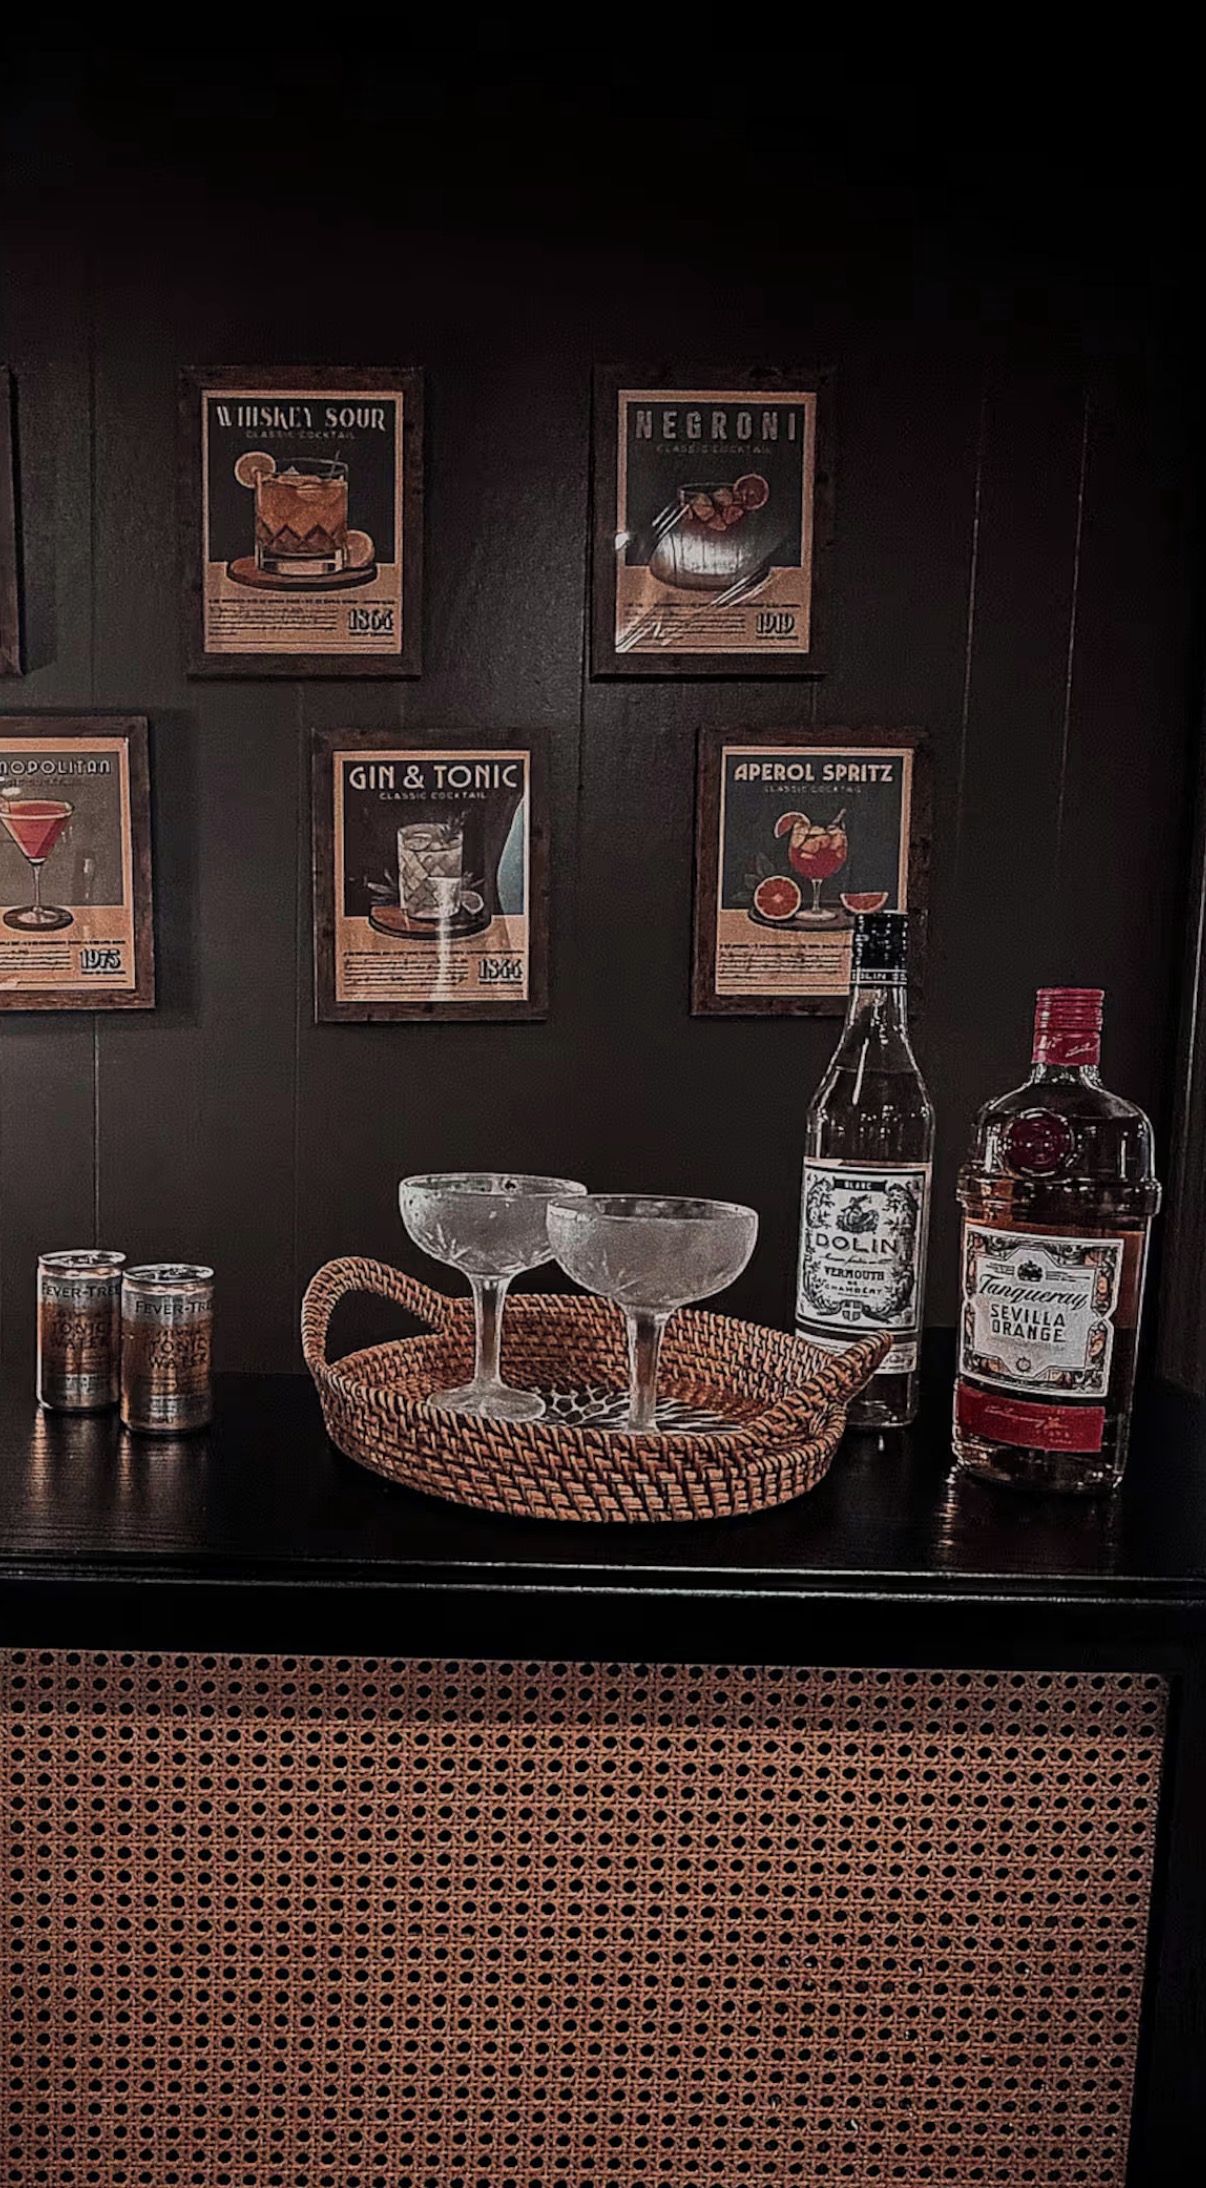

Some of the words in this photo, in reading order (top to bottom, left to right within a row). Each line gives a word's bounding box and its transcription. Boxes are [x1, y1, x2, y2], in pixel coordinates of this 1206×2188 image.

[216, 405, 312, 430] WHISKEY
[325, 407, 386, 432] SOUR
[635, 410, 796, 440] NEGRONI
[349, 765, 395, 790] GIN
[403, 764, 425, 789] &
[433, 764, 518, 789] TONIC
[734, 762, 815, 781] APEROL
[822, 763, 893, 782] SPRITZ
[379, 791, 426, 800] CLASSIC
[430, 791, 486, 800] COCKTAIL
[816, 1232, 899, 1254] DOLIN
[824, 1265, 885, 1281] VERMOUTH
[979, 1273, 1089, 1311] Tanqueray
[991, 1303, 1066, 1328] SEVILLA
[992, 1319, 1066, 1343] ORANGE
[151, 1338, 207, 1354] TONIC
